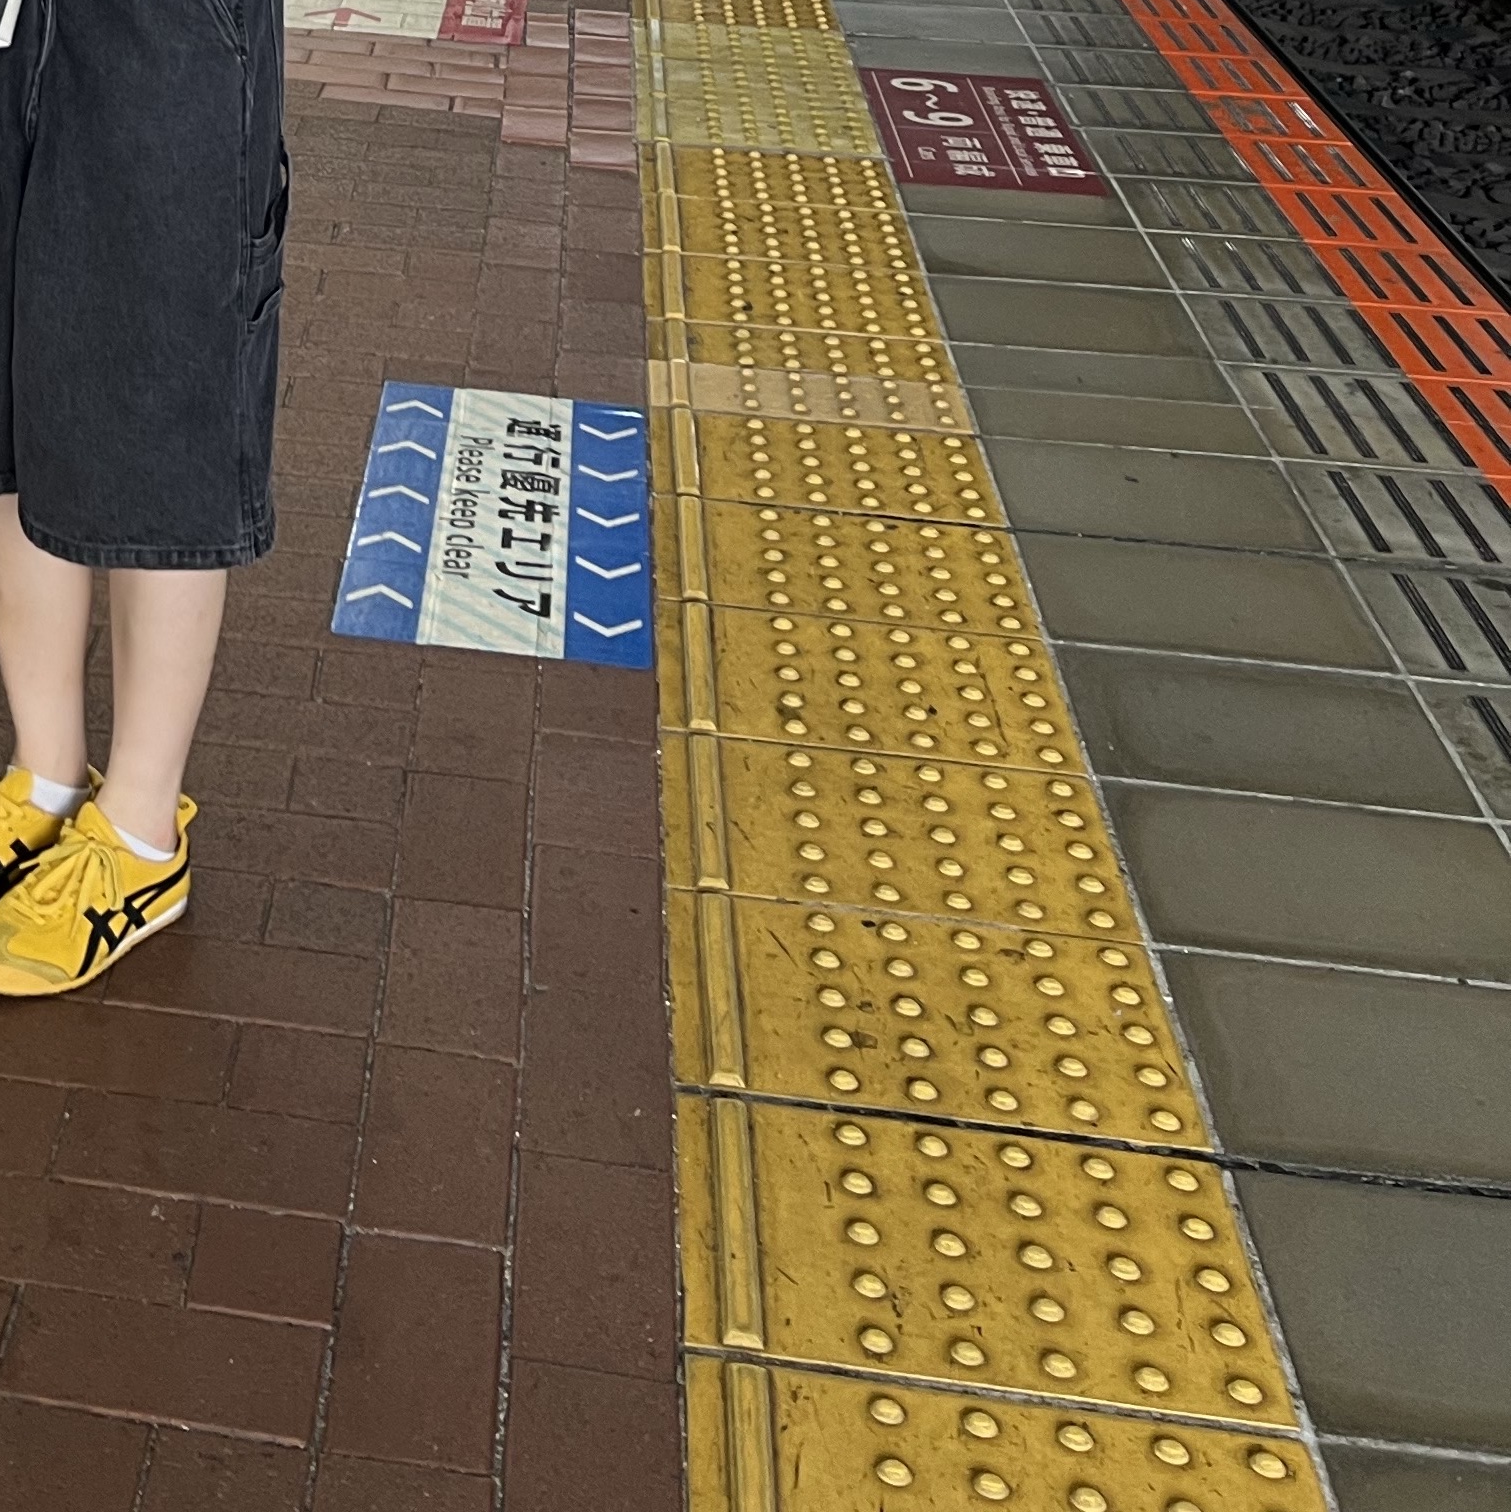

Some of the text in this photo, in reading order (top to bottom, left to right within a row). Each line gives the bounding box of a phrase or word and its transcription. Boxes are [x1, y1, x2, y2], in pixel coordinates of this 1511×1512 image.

[439, 435, 493, 580] Please keep clear
[492, 417, 562, 619] 通行優先エリア
